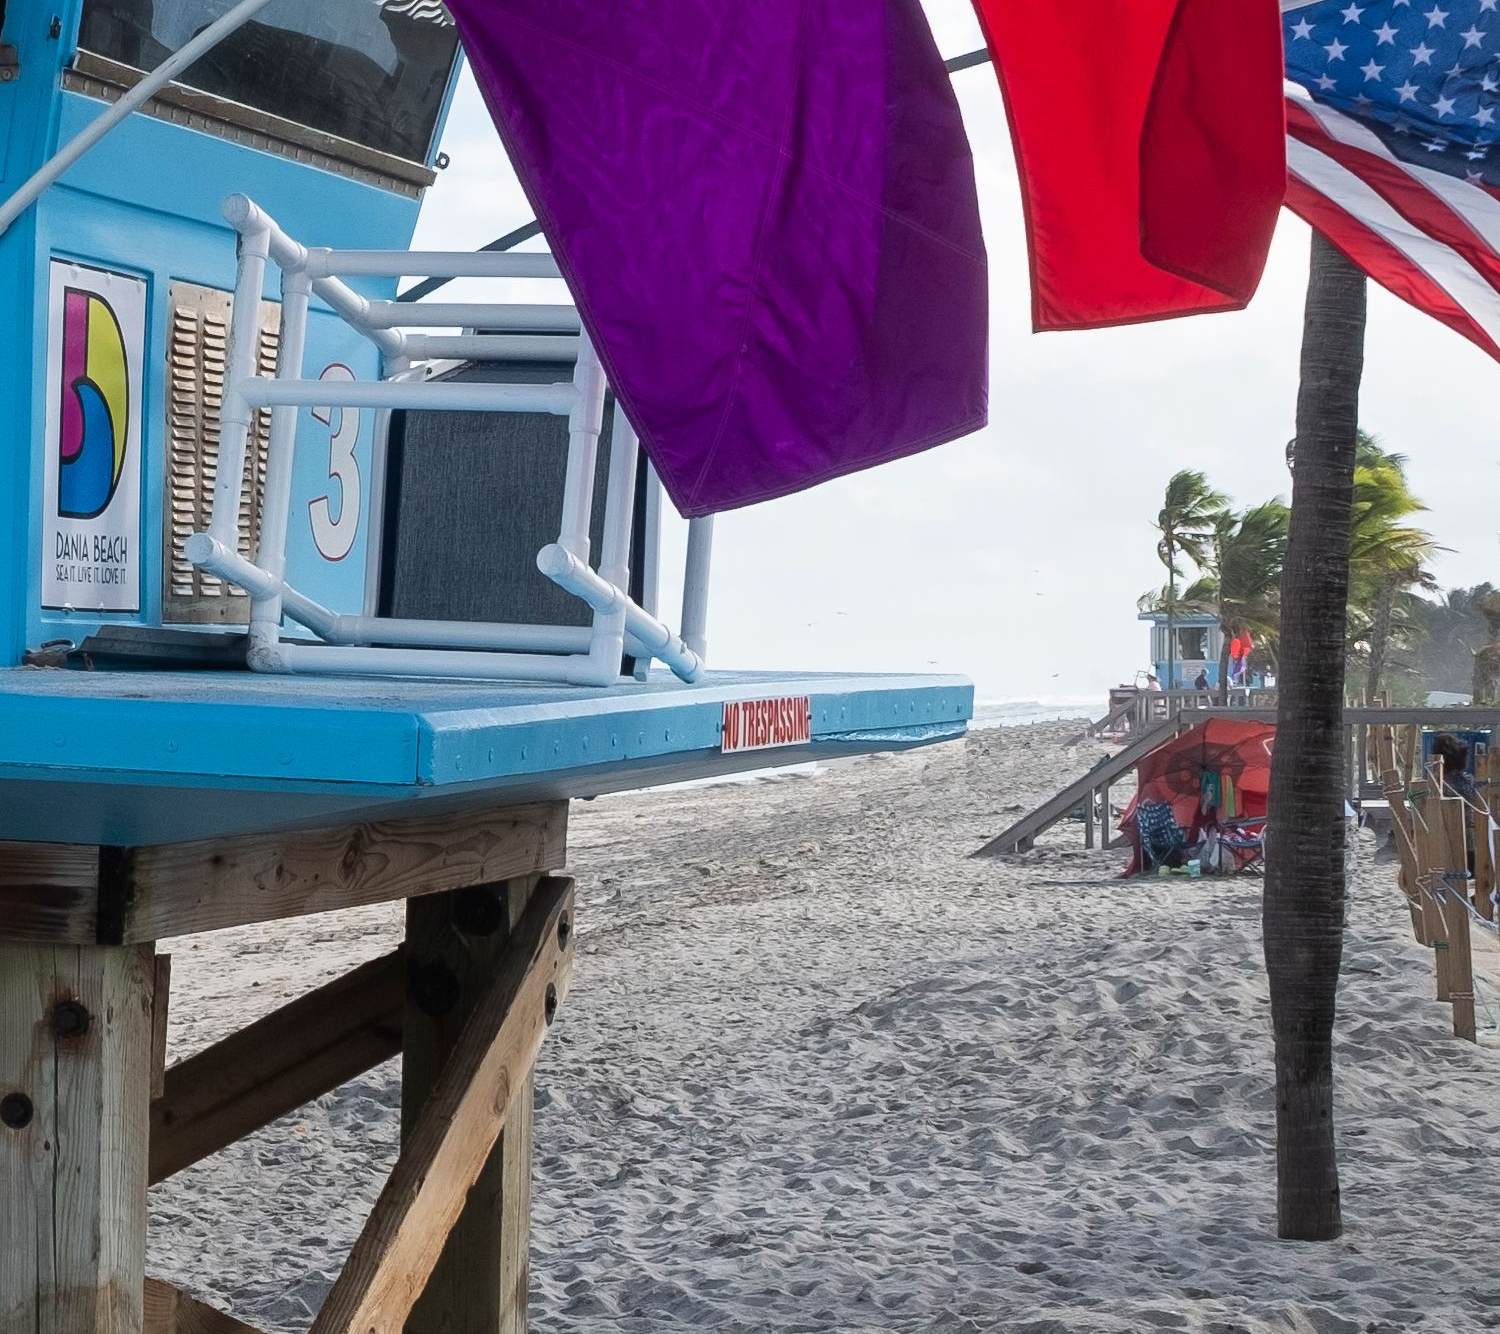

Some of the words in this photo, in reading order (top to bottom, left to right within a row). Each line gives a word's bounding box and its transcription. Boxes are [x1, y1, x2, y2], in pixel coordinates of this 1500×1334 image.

[308, 363, 360, 562] 3
[56, 531, 89, 562] DANIA
[94, 534, 128, 564] BEACH
[78, 566, 92, 583] LIVE
[102, 567, 119, 585] LOVE
[724, 702, 739, 750] NO
[742, 696, 809, 747] TRESPASSING
